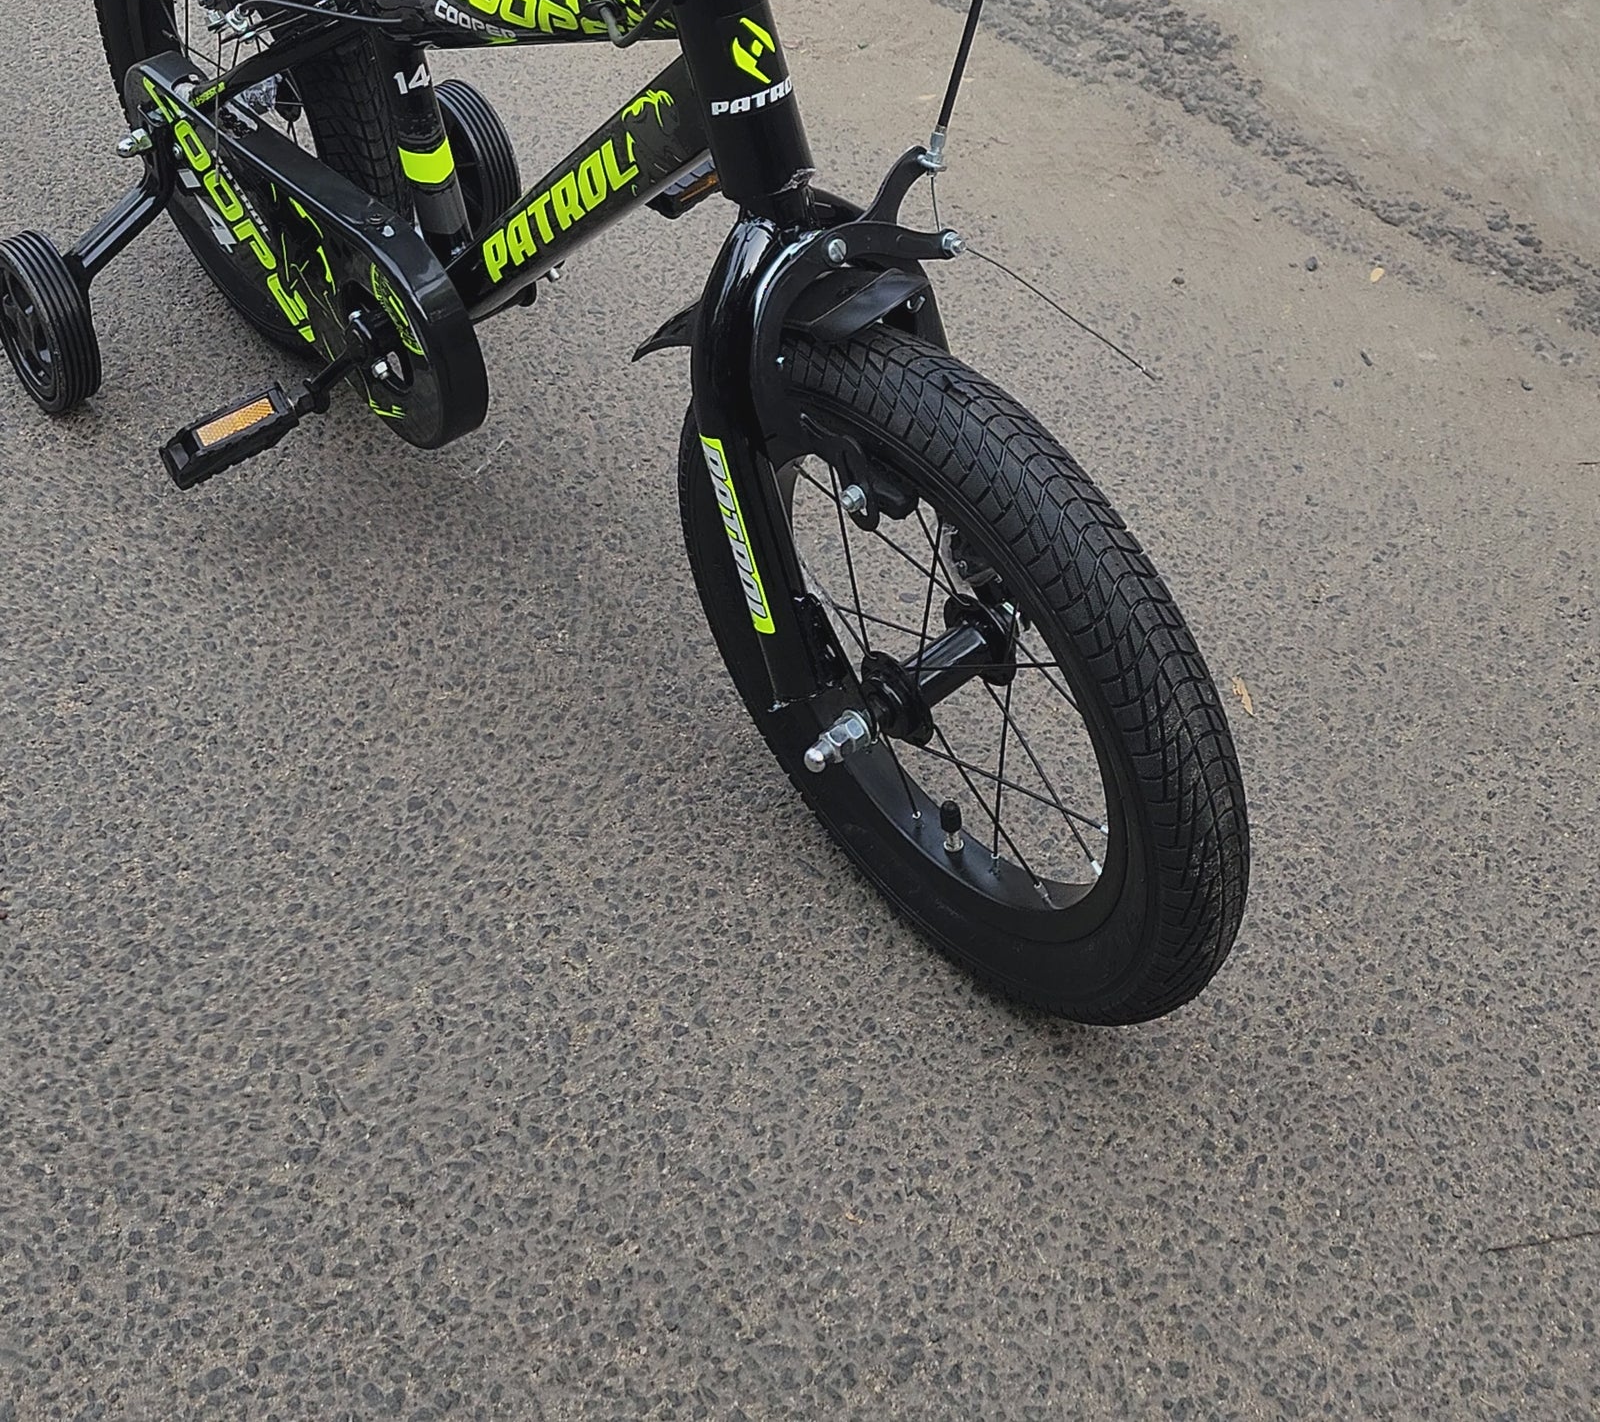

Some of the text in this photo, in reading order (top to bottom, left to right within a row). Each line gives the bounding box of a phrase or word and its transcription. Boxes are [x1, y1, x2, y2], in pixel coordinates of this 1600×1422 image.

[434, 0, 517, 39] COOPER
[393, 63, 430, 94] 14
[483, 138, 639, 282] PATROL
